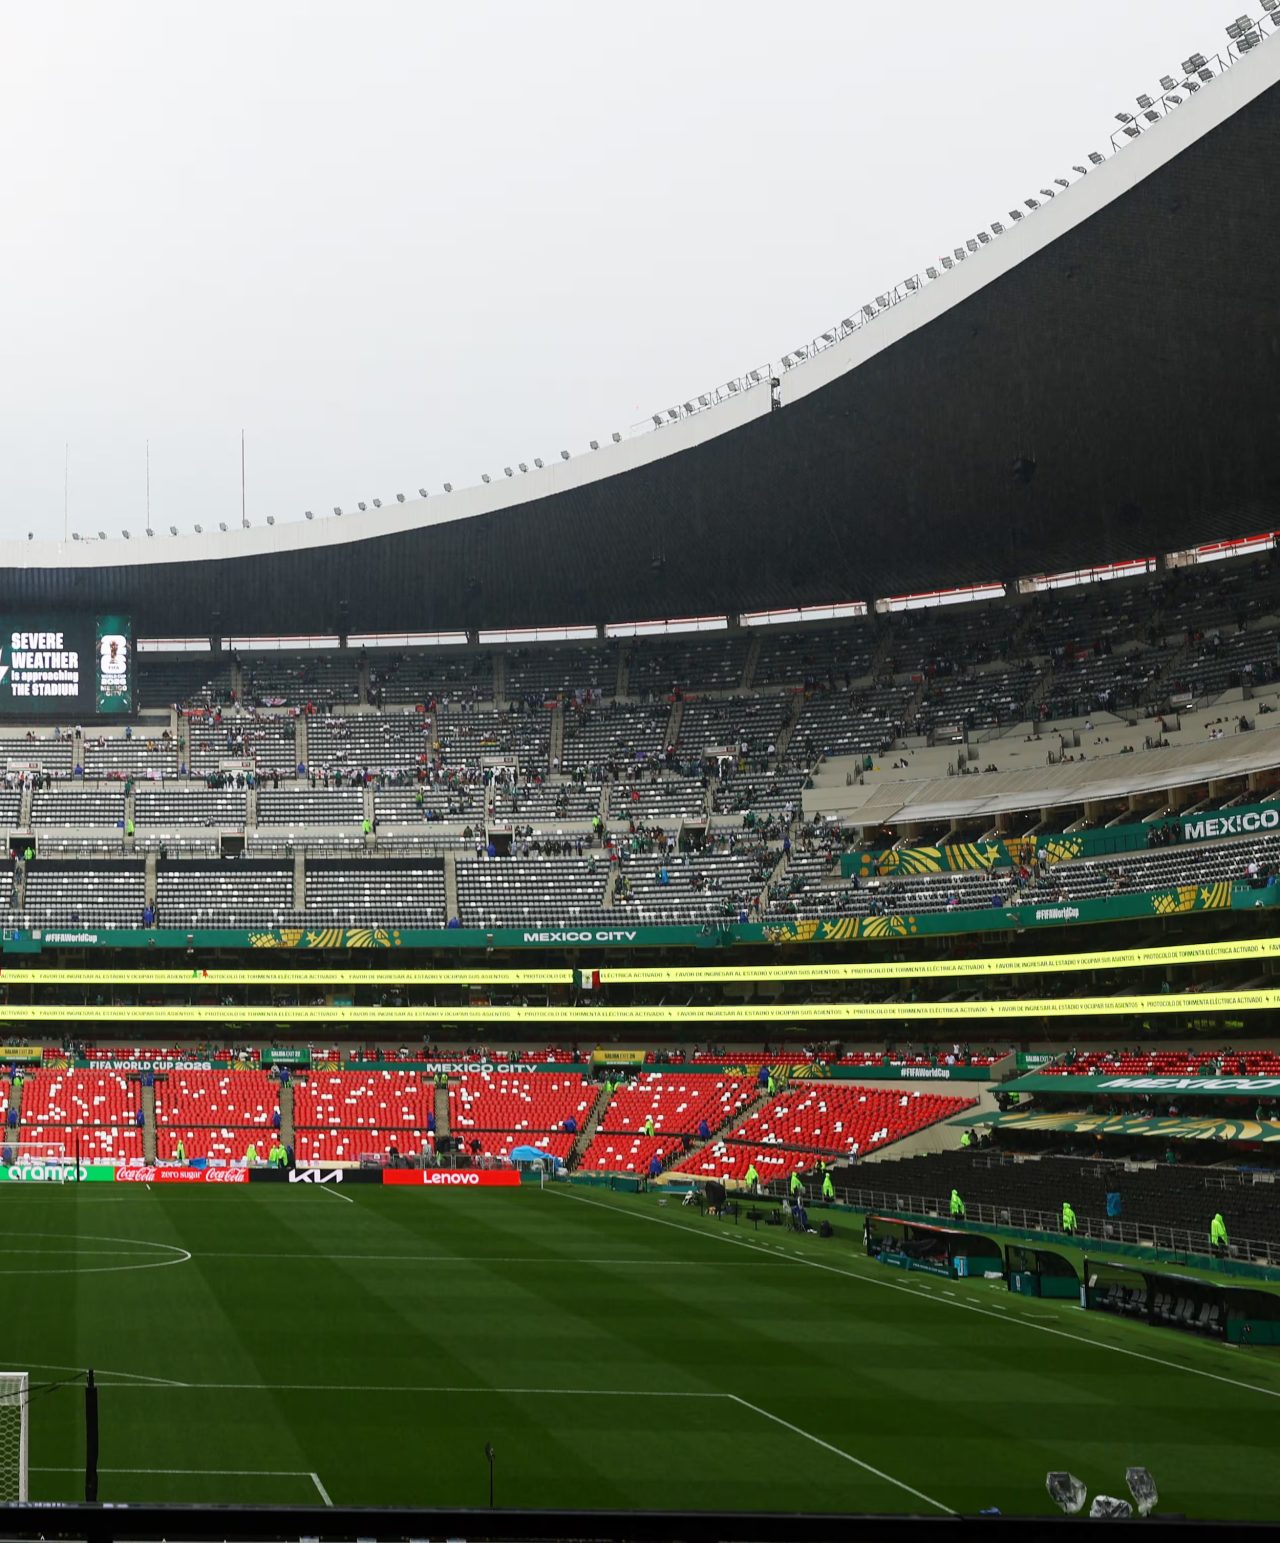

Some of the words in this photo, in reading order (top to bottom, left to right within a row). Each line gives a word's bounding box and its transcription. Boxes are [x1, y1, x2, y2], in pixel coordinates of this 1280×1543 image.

[12, 632, 64, 650] SEVERE
[12, 652, 78, 668] WEATHER
[22, 670, 78, 682] approaching
[11, 684, 30, 696] THE
[32, 684, 78, 696] STADIUM
[1185, 810, 1279, 840] MEXICO
[1036, 906, 1080, 920] #FIFAWorldCup
[45, 933, 98, 944] #FIFAWorldCup
[524, 932, 592, 942] MEXICO
[596, 932, 636, 941] CITY
[90, 1061, 112, 1070] FIFA
[114, 1061, 151, 1070] WORLD
[152, 1061, 173, 1070] CUP
[175, 1062, 212, 1070] 2026
[426, 1063, 493, 1072] MEXICO
[498, 1064, 537, 1073] CITY
[900, 1068, 950, 1079] #FIFAWorldCup
[1097, 1078, 1280, 1090] MEXICO
[8, 1166, 87, 1180] aramco
[116, 1166, 156, 1182] Coca-Cola
[161, 1170, 178, 1179] zero
[180, 1170, 202, 1180] sugar
[205, 1166, 245, 1182] Coca-Cola
[288, 1169, 344, 1183] KIA
[423, 1170, 479, 1184] Lenovo
